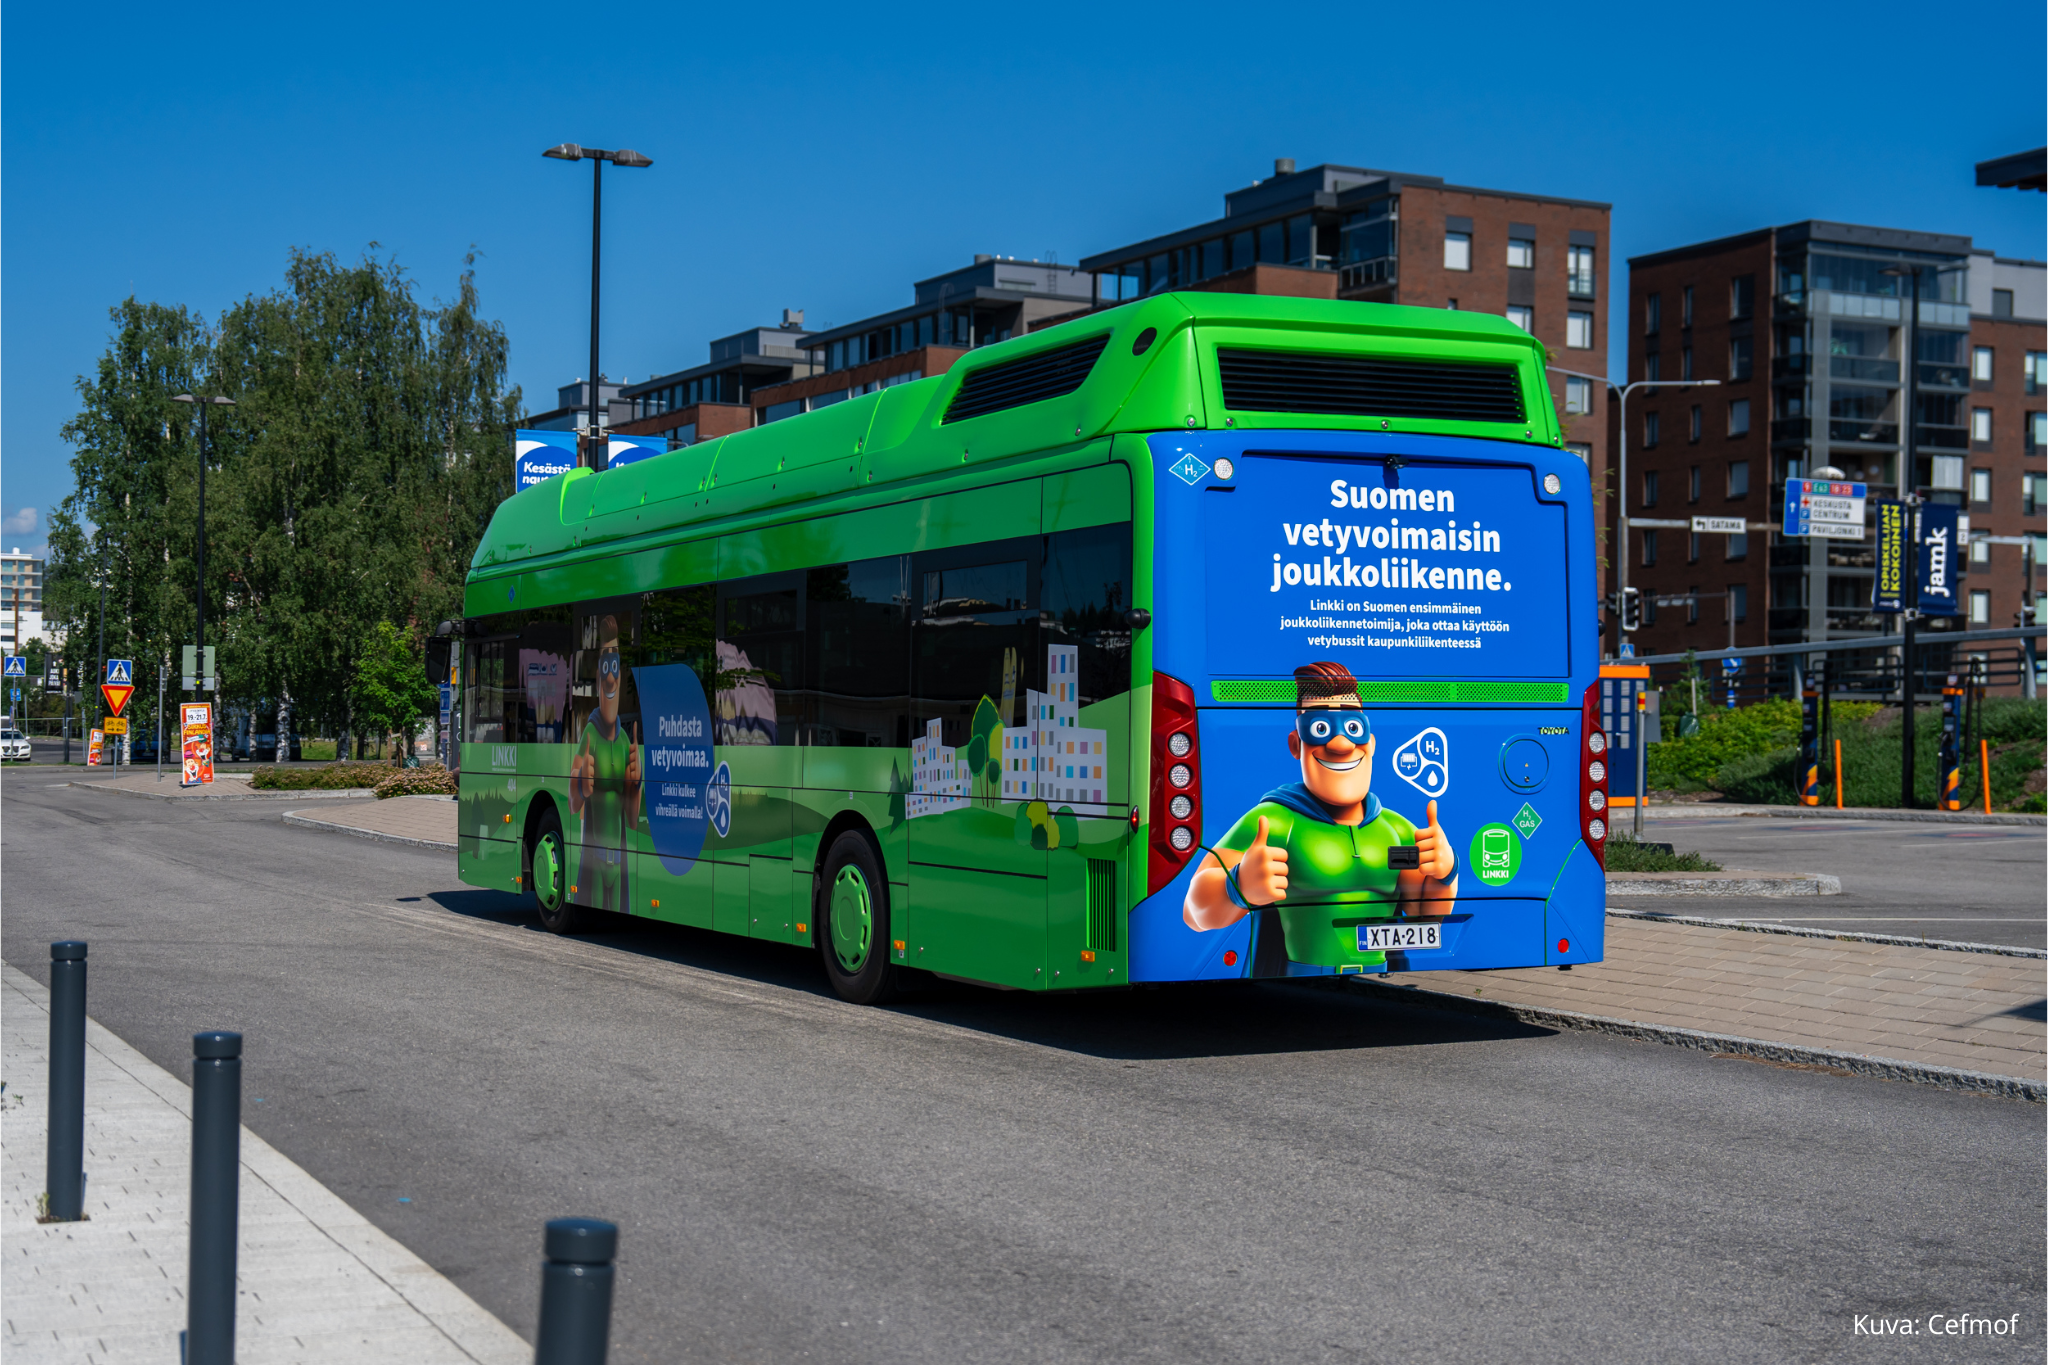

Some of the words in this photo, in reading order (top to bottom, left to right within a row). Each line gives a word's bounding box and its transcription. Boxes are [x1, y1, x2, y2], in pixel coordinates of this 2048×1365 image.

[524, 461, 571, 474] Kesästä
[1330, 479, 1455, 512] Suomen
[1814, 500, 1852, 511] KESKUSTA
[1813, 509, 1850, 519] CENTRUM
[1711, 520, 1741, 530] SATAMA
[1812, 525, 1855, 536] PAVILJONKI
[1283, 518, 1501, 555] vetyvoimaisin
[1881, 504, 1890, 591] OPISKELIJAN
[1890, 505, 1901, 591] KOKOINEN
[1924, 526, 1950, 598] jamk
[1270, 553, 1512, 592] joukkoliikenne.
[1310, 599, 1345, 612] Linkki
[1346, 602, 1361, 612] on
[1363, 601, 1407, 613] Suomen
[1409, 602, 1482, 614] ensimmäinen
[1280, 616, 1405, 632] joukkoliikennetoimija,
[1406, 618, 1430, 632] joka
[1432, 620, 1460, 631] ottaa
[1462, 620, 1510, 634] käyttöön
[1308, 635, 1365, 649] vetybussit
[1367, 635, 1482, 650] kaupunkiliikenteessä
[659, 714, 702, 737] Puhdasta
[1537, 727, 1570, 735] TOYOTA
[492, 745, 517, 767] LINKKI
[651, 743, 709, 772] vetyvoimaa.
[507, 778, 516, 792] 404
[662, 783, 678, 796] Linkki
[678, 784, 696, 798] kulkee
[655, 803, 678, 817] vihreällä
[678, 805, 703, 819] voimalla!
[1520, 820, 1535, 828] GAS
[1482, 870, 1509, 878] LINKKI
[1371, 927, 1436, 946] XTA-218
